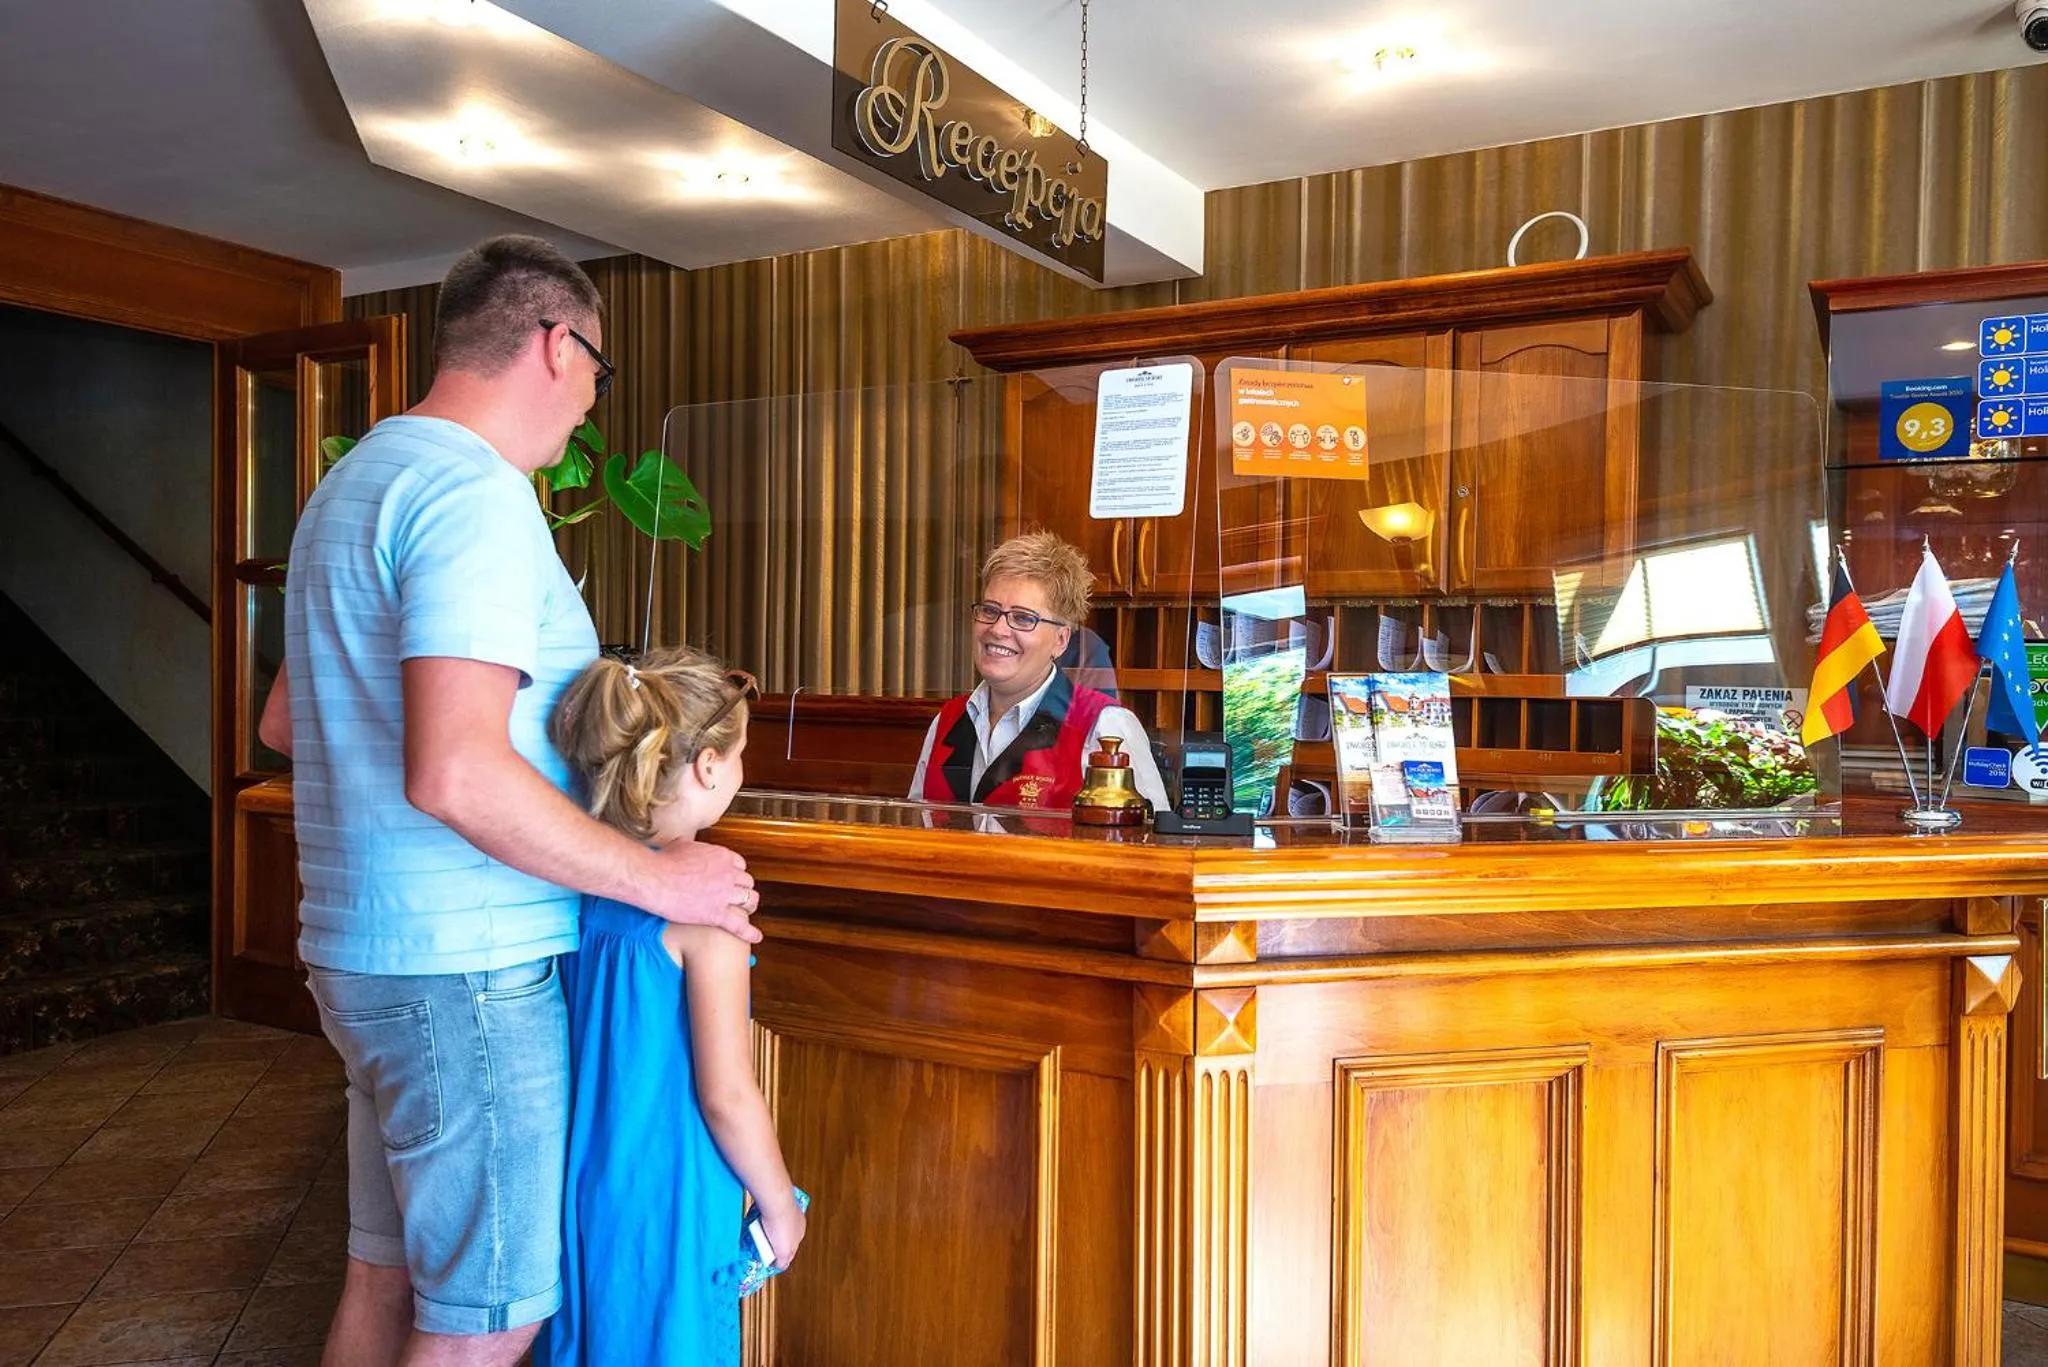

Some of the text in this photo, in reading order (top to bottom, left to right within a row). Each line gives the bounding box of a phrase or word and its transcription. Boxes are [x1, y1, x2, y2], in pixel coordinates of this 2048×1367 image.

[856, 36, 1103, 247] Recepcja
[1905, 384, 1947, 392] Booking.com
[1904, 417, 1946, 439] 9,3
[1700, 688, 1793, 701] ZAKAZ PALENIA
